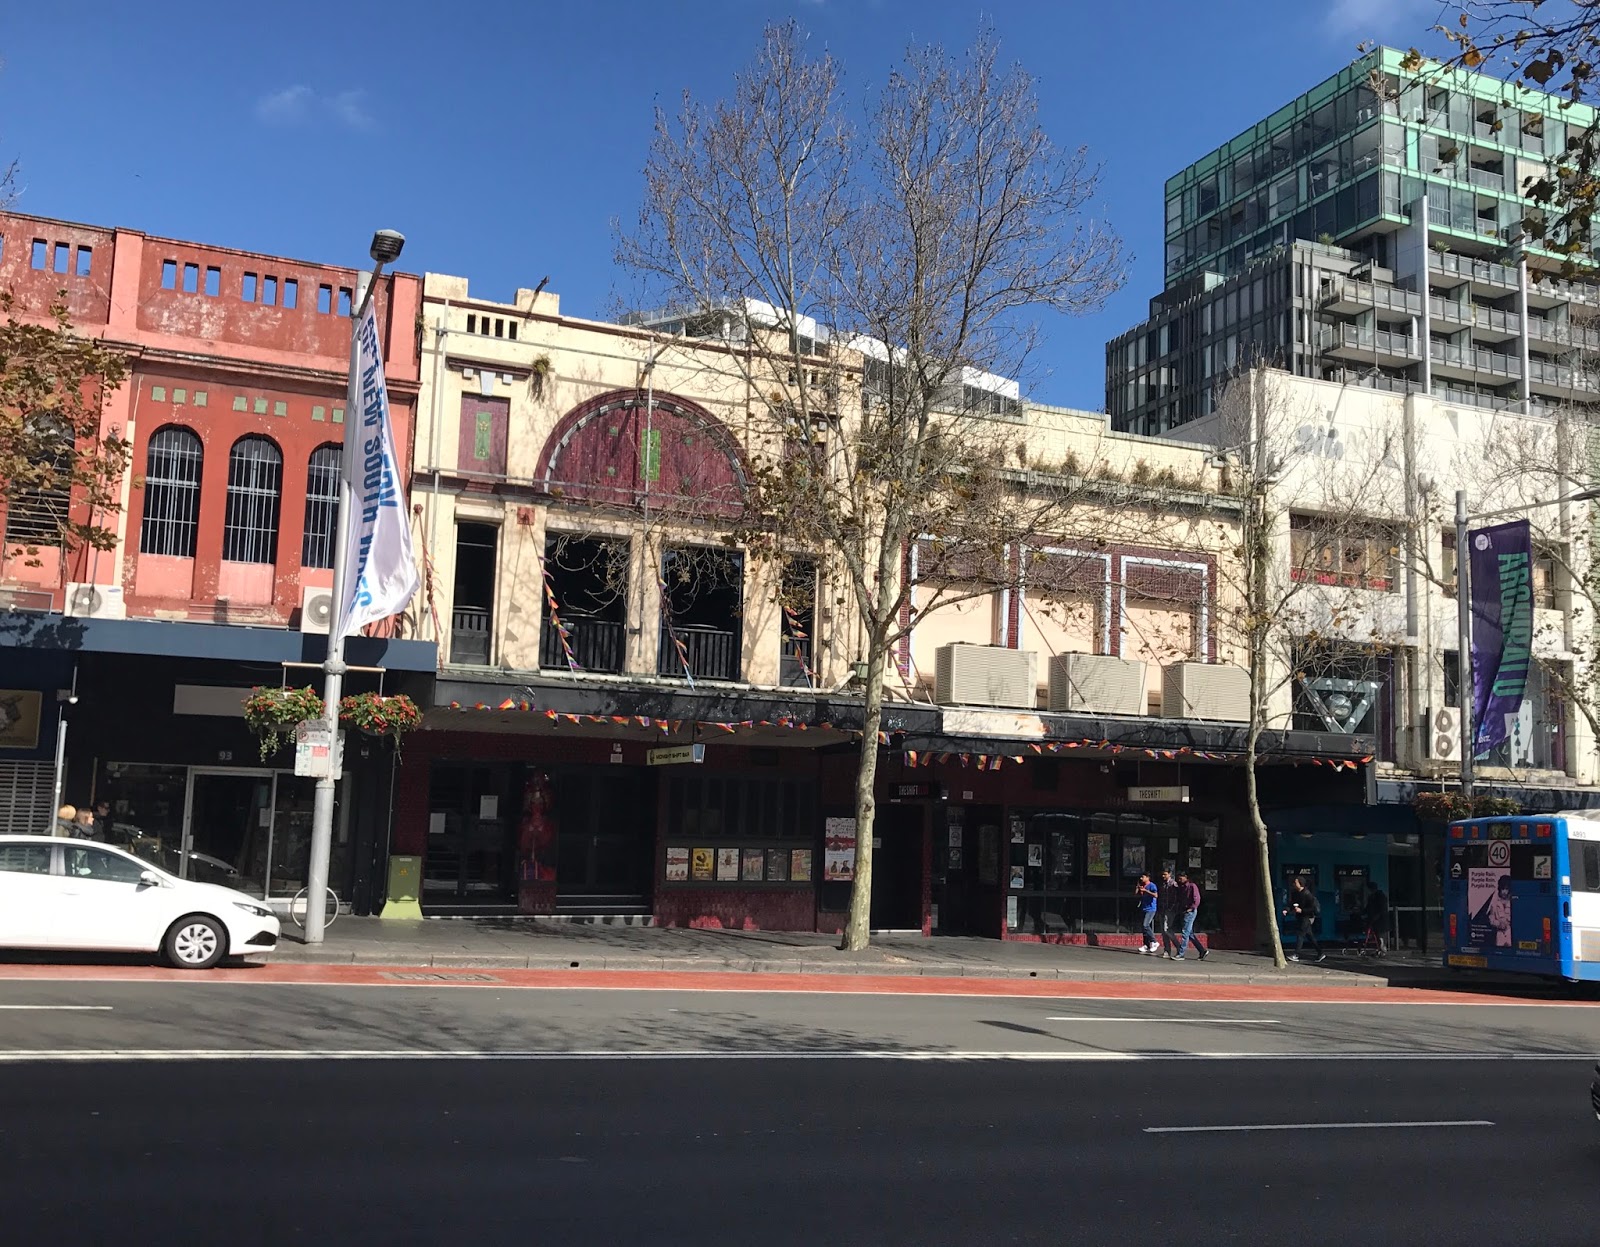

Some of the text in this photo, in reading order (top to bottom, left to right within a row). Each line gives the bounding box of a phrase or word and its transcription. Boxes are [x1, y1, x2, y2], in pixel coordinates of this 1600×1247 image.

[362, 365, 380, 427] NEW
[363, 436, 383, 523] SOUTH
[219, 751, 232, 761] 93
[1572, 830, 1587, 839] 4893
[1492, 846, 1507, 860] 40
